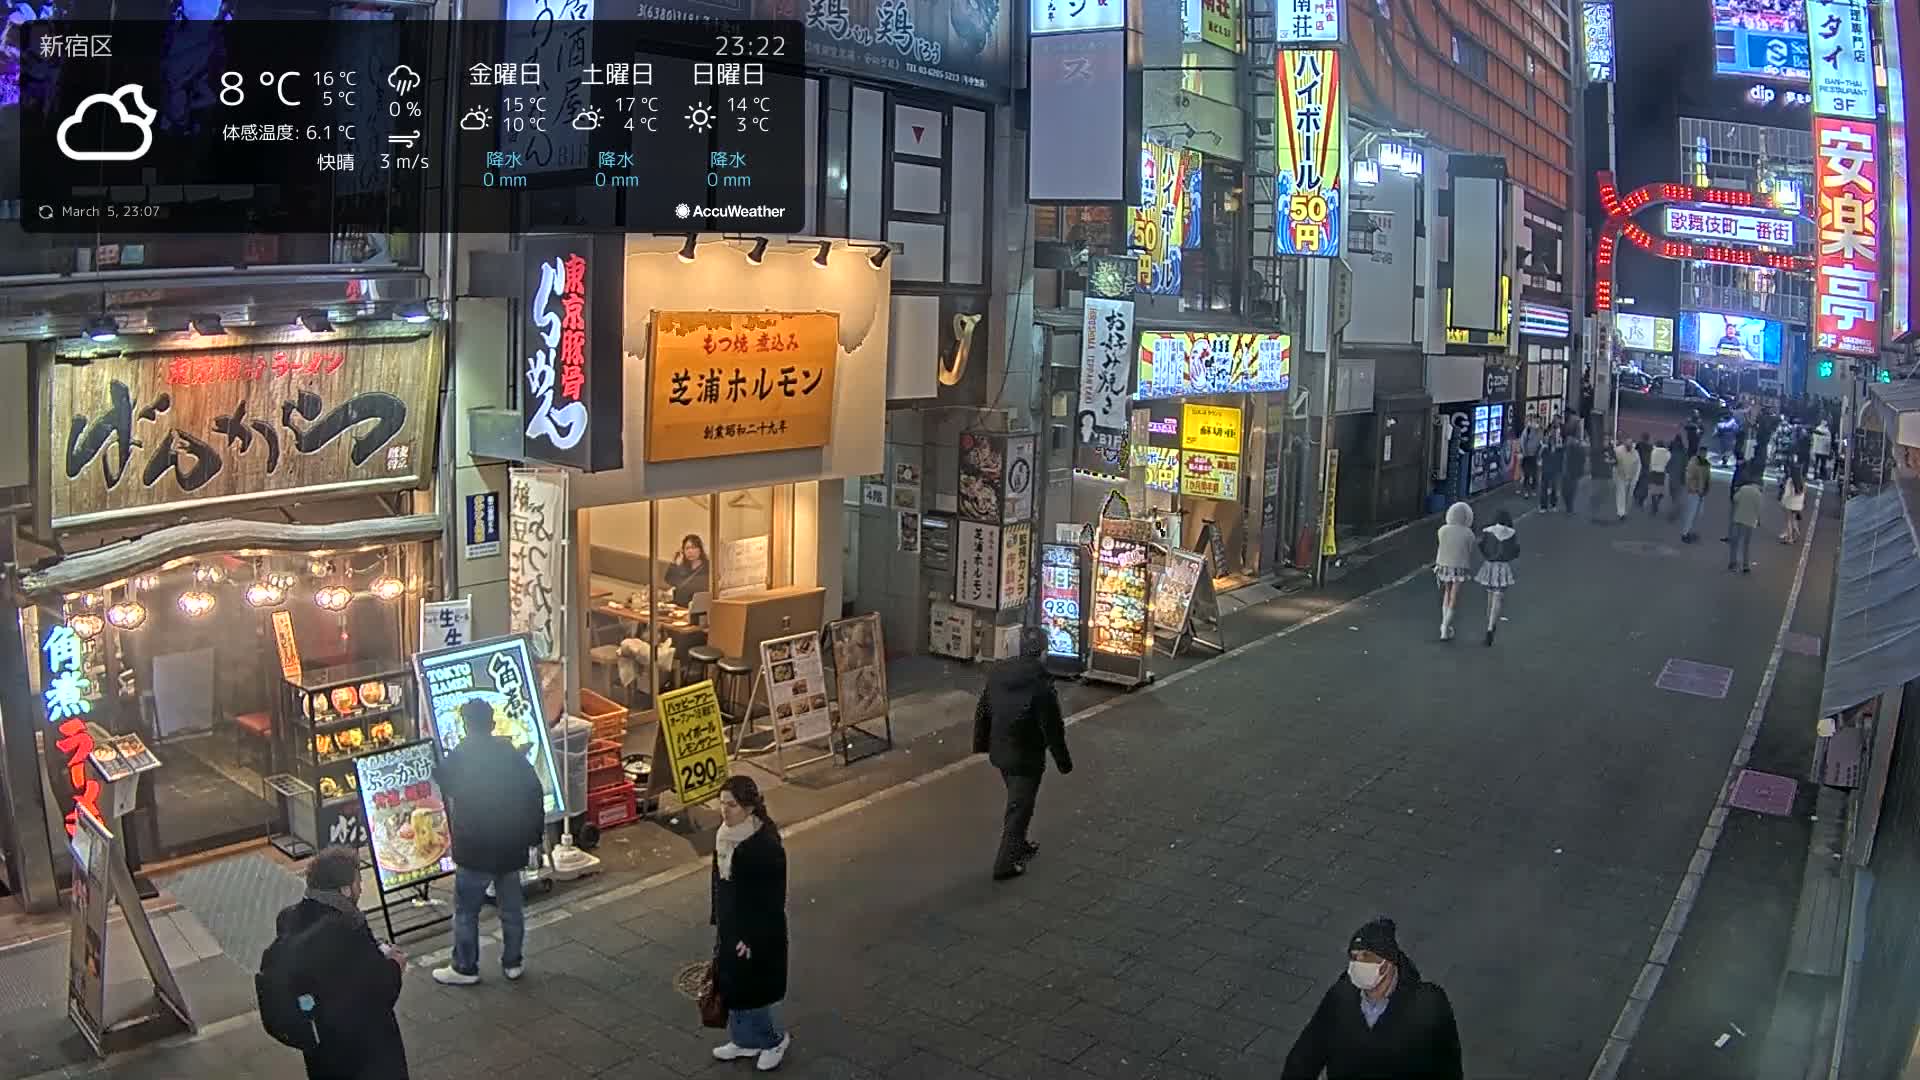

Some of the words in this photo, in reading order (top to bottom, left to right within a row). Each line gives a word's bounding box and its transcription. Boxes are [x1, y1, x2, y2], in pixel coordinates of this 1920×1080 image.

[1750, 85, 1775, 103] dip
[1833, 98, 1857, 111] 3F
[1293, 54, 1325, 191] ハイボール
[1670, 211, 1790, 243] 歌舞伎町一番街
[1817, 125, 1876, 331] 安楽亭
[560, 252, 586, 401] 東京豚骨
[1818, 333, 1837, 347] 2F
[703, 334, 749, 354] もつ焼
[756, 332, 799, 352] 煮込み
[1097, 308, 1128, 415] お好み焼き
[669, 366, 824, 405] 芝浦ホルモン
[703, 420, 788, 440] 創業昭和二十九年
[973, 527, 984, 601] 芝浦ホルモン
[677, 722, 716, 744] ハイボール
[681, 758, 717, 789] 290
